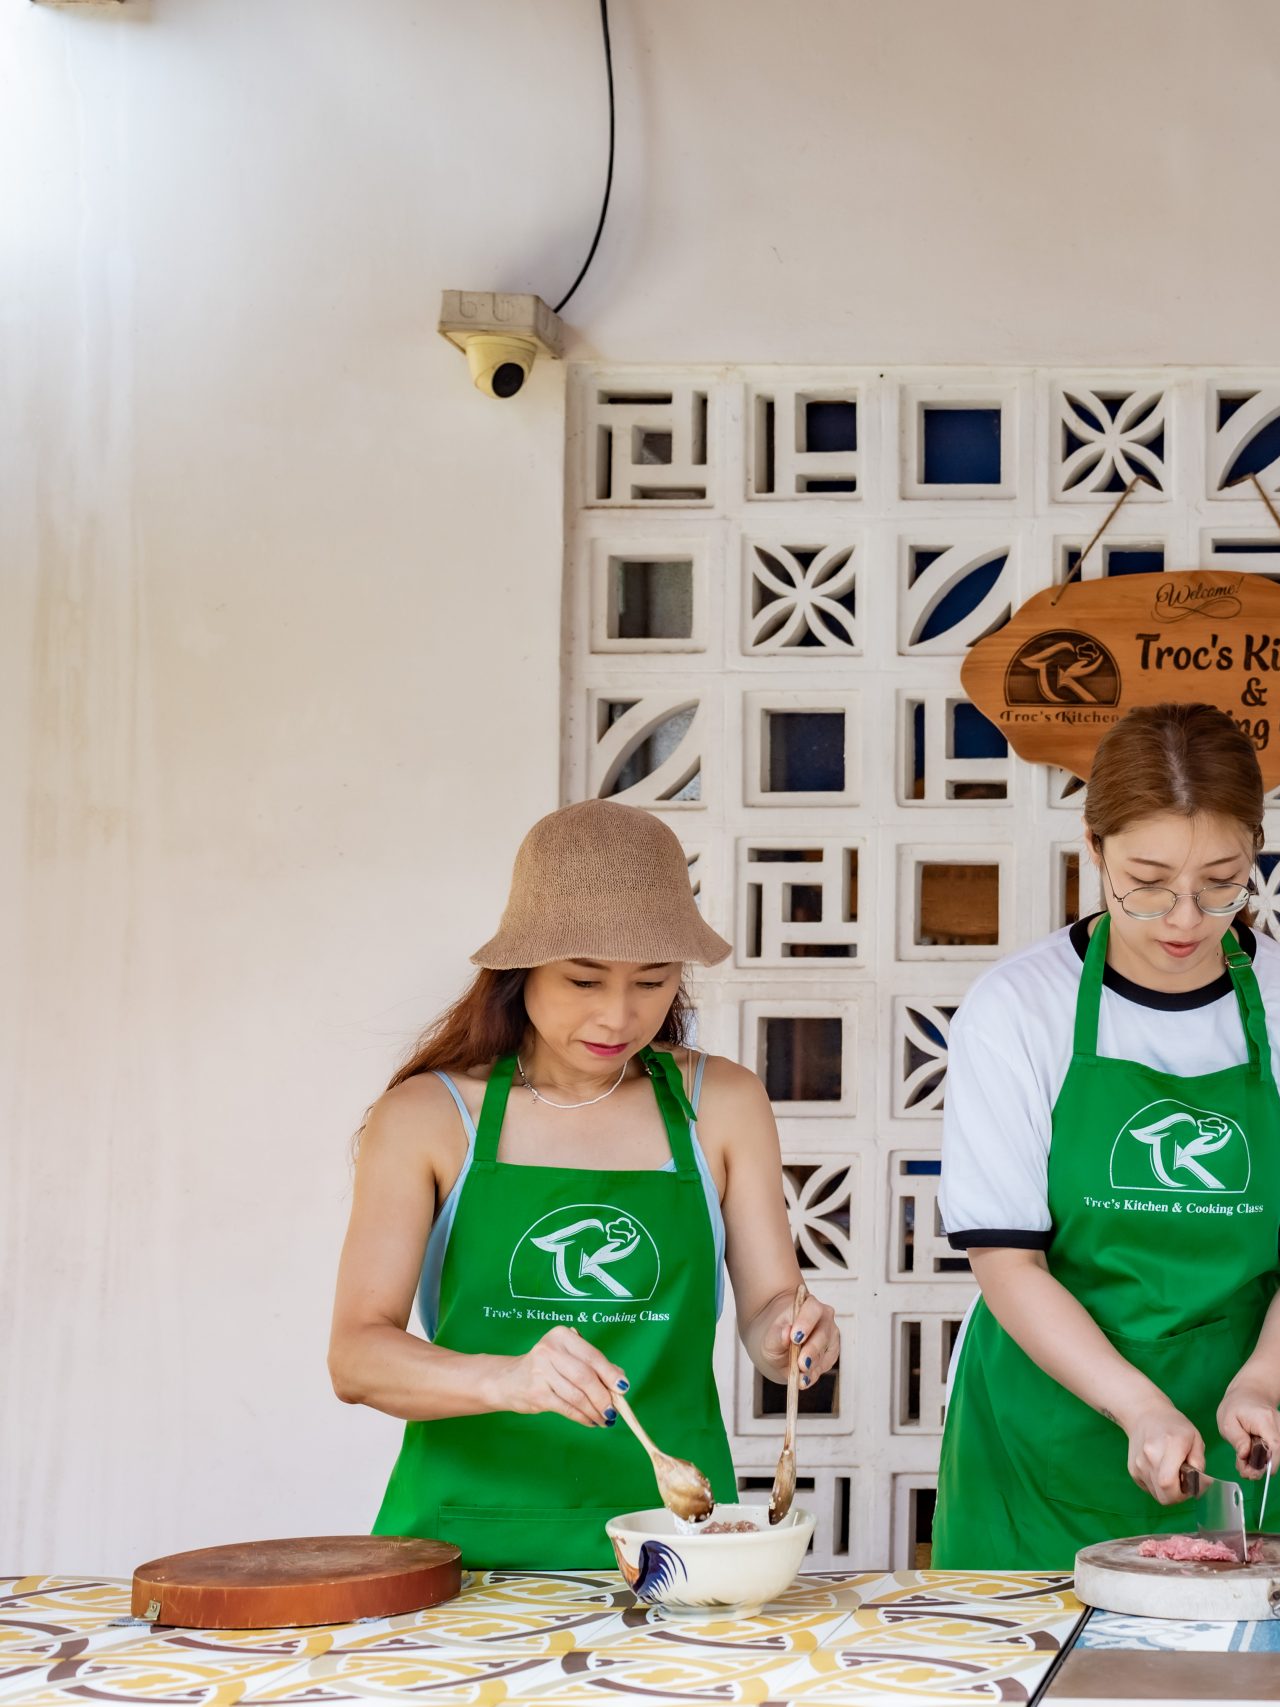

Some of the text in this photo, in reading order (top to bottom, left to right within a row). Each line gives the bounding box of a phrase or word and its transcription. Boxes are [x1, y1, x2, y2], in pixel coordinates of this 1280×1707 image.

[1135, 633, 1234, 671] Troc's
[1240, 677, 1268, 707] &
[999, 710, 1120, 725] Troc's Kitchen
[1123, 1199, 1169, 1213] Kitchen
[1171, 1202, 1183, 1214] &
[1186, 1202, 1234, 1217] Cooking
[1236, 1203, 1264, 1214] Class
[483, 1306, 670, 1324] Troc's Kitchen & Cooking Class
